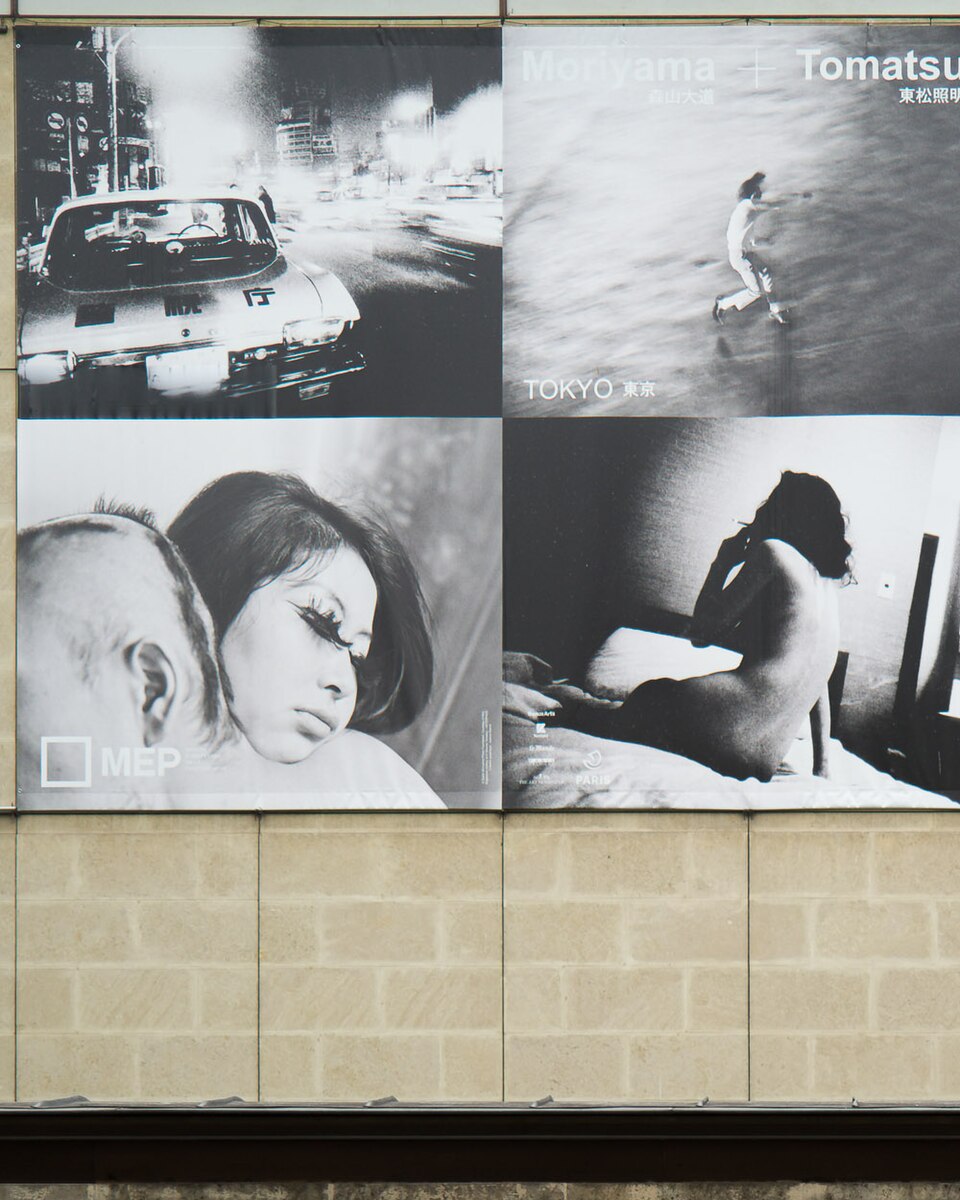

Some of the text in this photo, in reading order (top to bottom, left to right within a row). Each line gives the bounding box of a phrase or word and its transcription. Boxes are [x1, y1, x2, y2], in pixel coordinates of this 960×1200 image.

[522, 49, 715, 90] Moriyama
[648, 88, 715, 105] 森山大道
[523, 378, 657, 400] TOKYO 東京
[101, 747, 182, 777] MEP
[576, 775, 610, 785] PARIS
